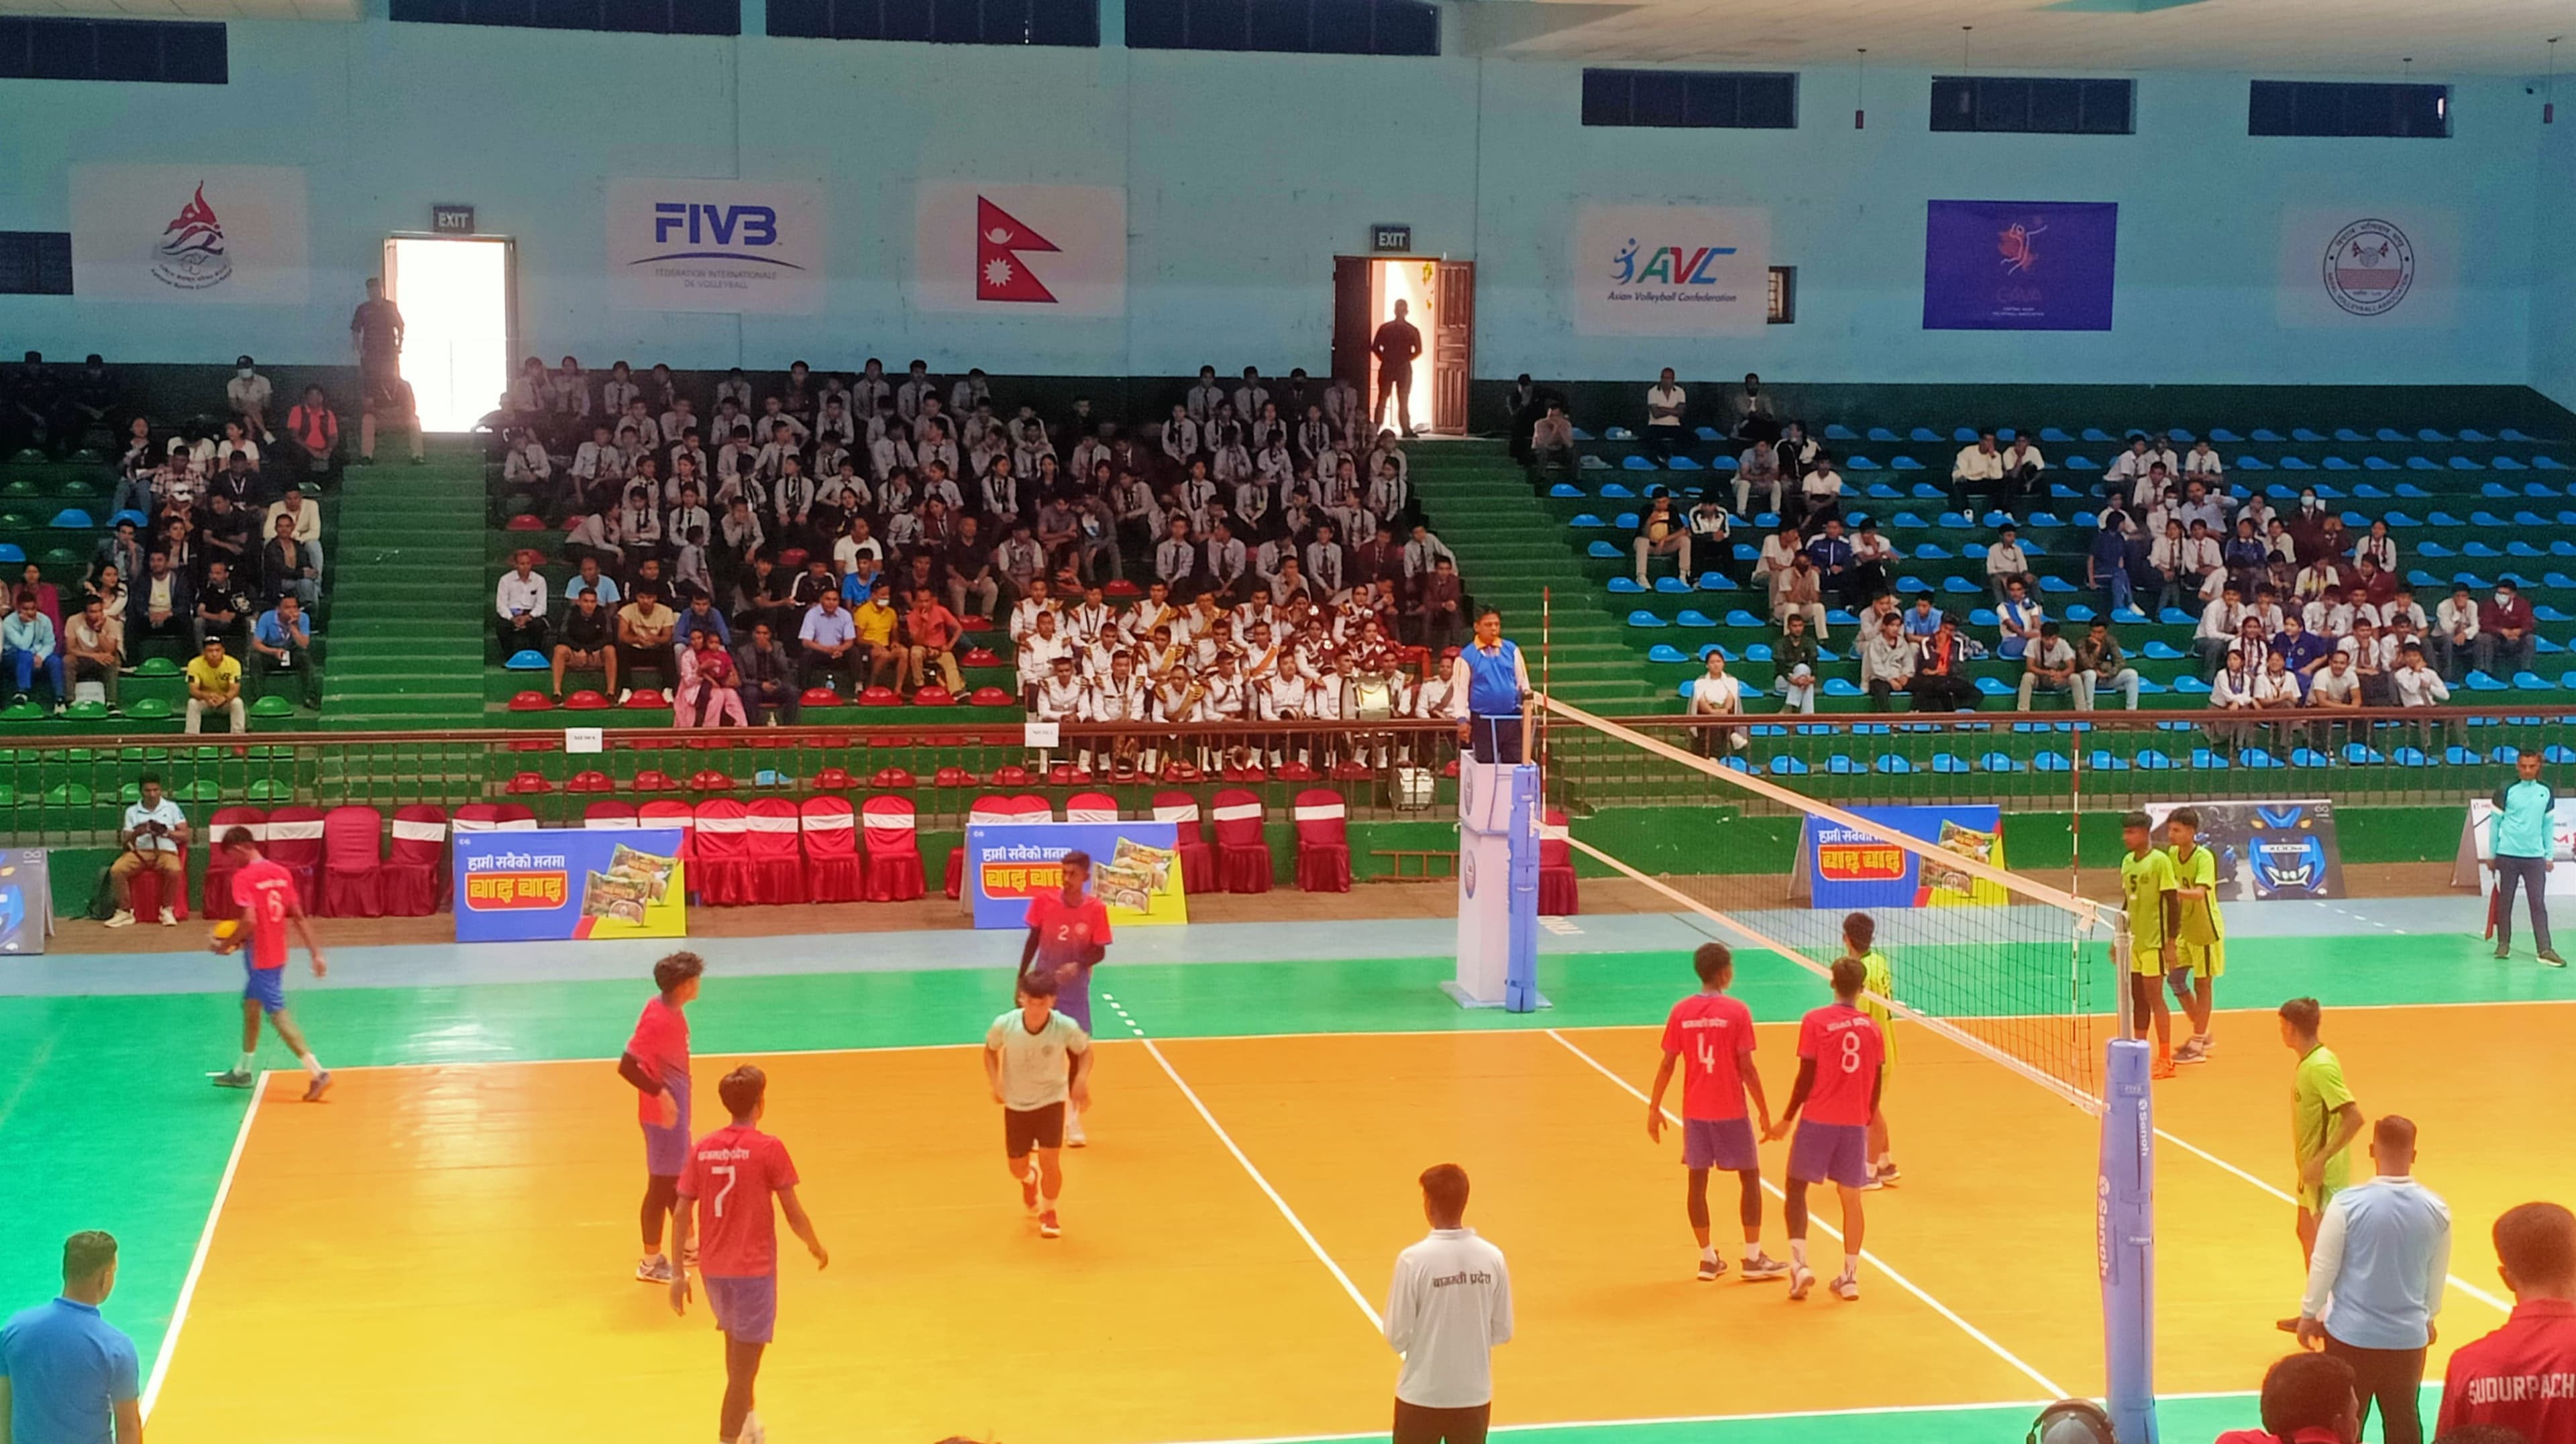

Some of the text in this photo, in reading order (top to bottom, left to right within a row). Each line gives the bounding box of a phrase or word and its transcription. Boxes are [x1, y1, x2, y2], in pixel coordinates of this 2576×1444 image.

[439, 212, 469, 228] EXIT
[655, 203, 777, 245] FIVB
[1379, 232, 1406, 247] EXIT
[1636, 247, 1737, 284] AVC
[1635, 291, 1676, 303] Volleyball
[1678, 292, 1737, 302] Confederation
[468, 854, 494, 871] हामी
[532, 854, 566, 869] मनमा
[981, 846, 1006, 862] हामी
[2130, 873, 2137, 893] 5
[1058, 925, 1069, 941] 2
[1697, 1032, 1715, 1074] 4
[1841, 1031, 1860, 1073] 8
[711, 1165, 735, 1217] 7
